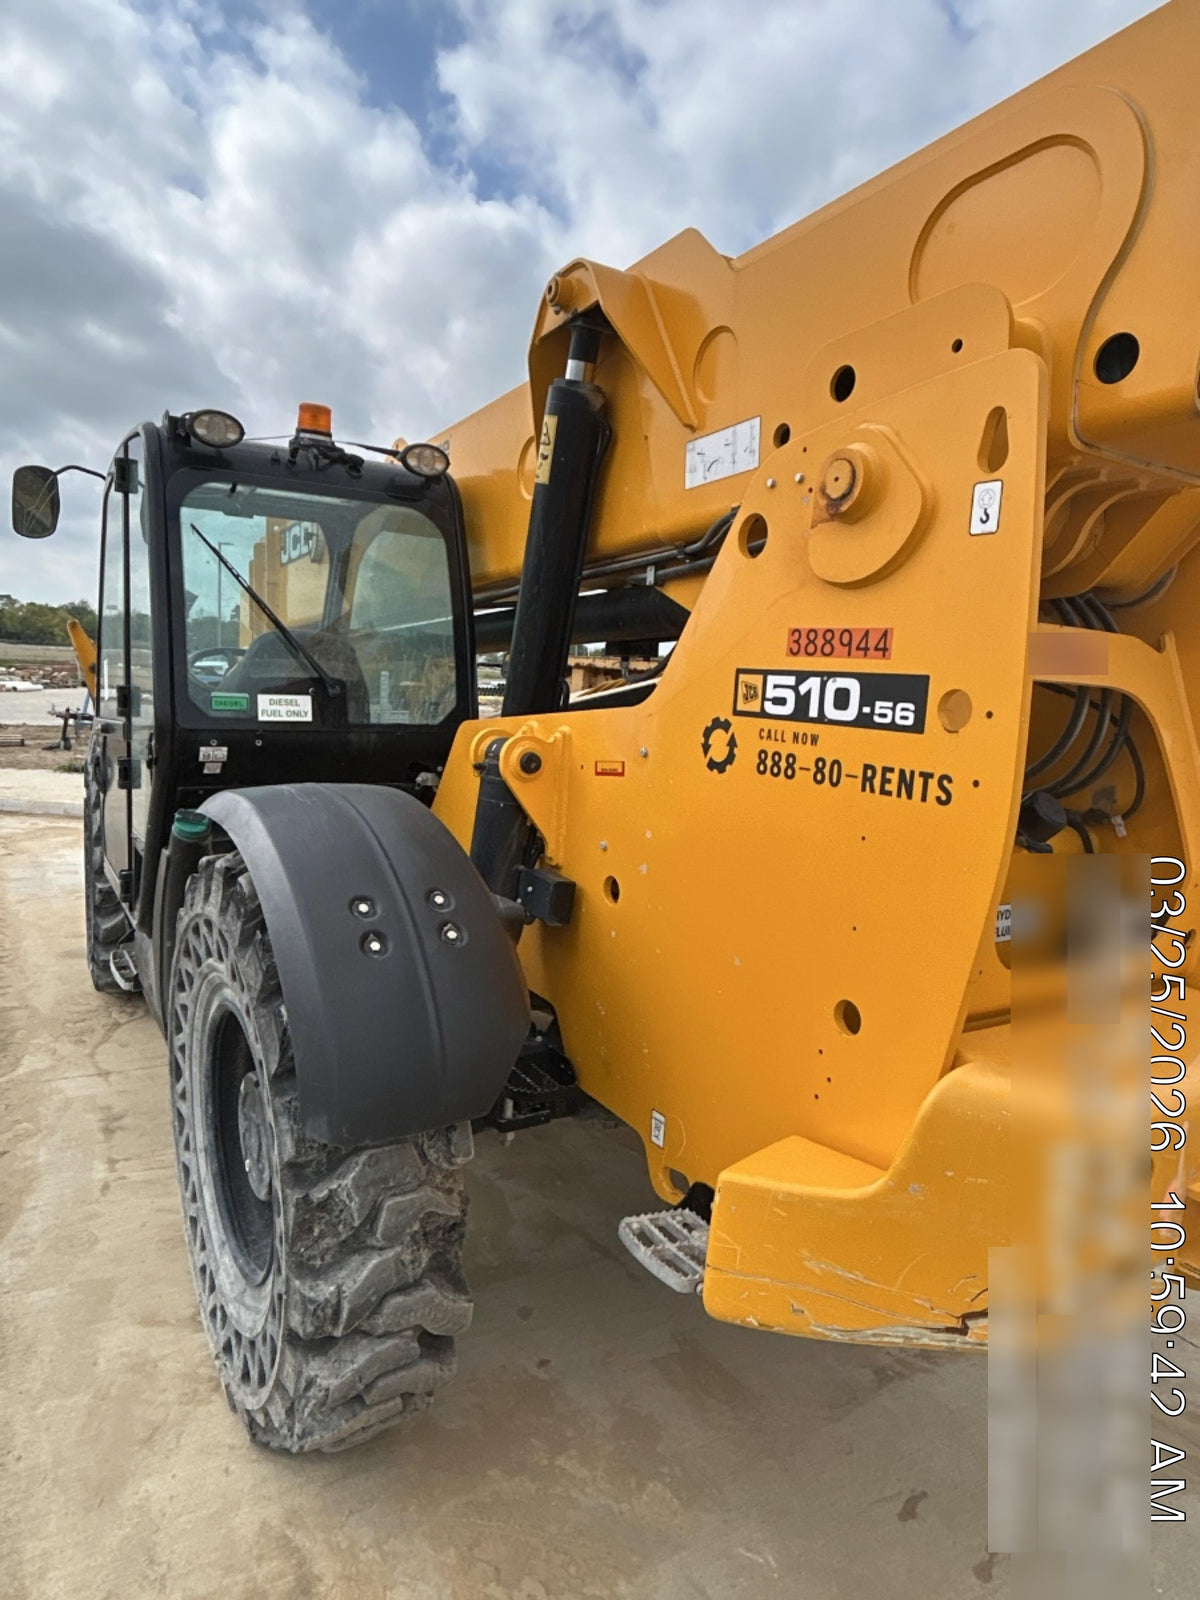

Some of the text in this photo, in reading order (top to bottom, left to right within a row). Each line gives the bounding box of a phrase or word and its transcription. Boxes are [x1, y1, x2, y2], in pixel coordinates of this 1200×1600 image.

[789, 628, 890, 658] 388944
[214, 700, 244, 708] DIESEL
[269, 698, 300, 707] DIESEL
[261, 709, 309, 718] FUEL ONLY
[759, 728, 820, 747] CALL NOW
[756, 749, 954, 806] 888-80-RENTS
